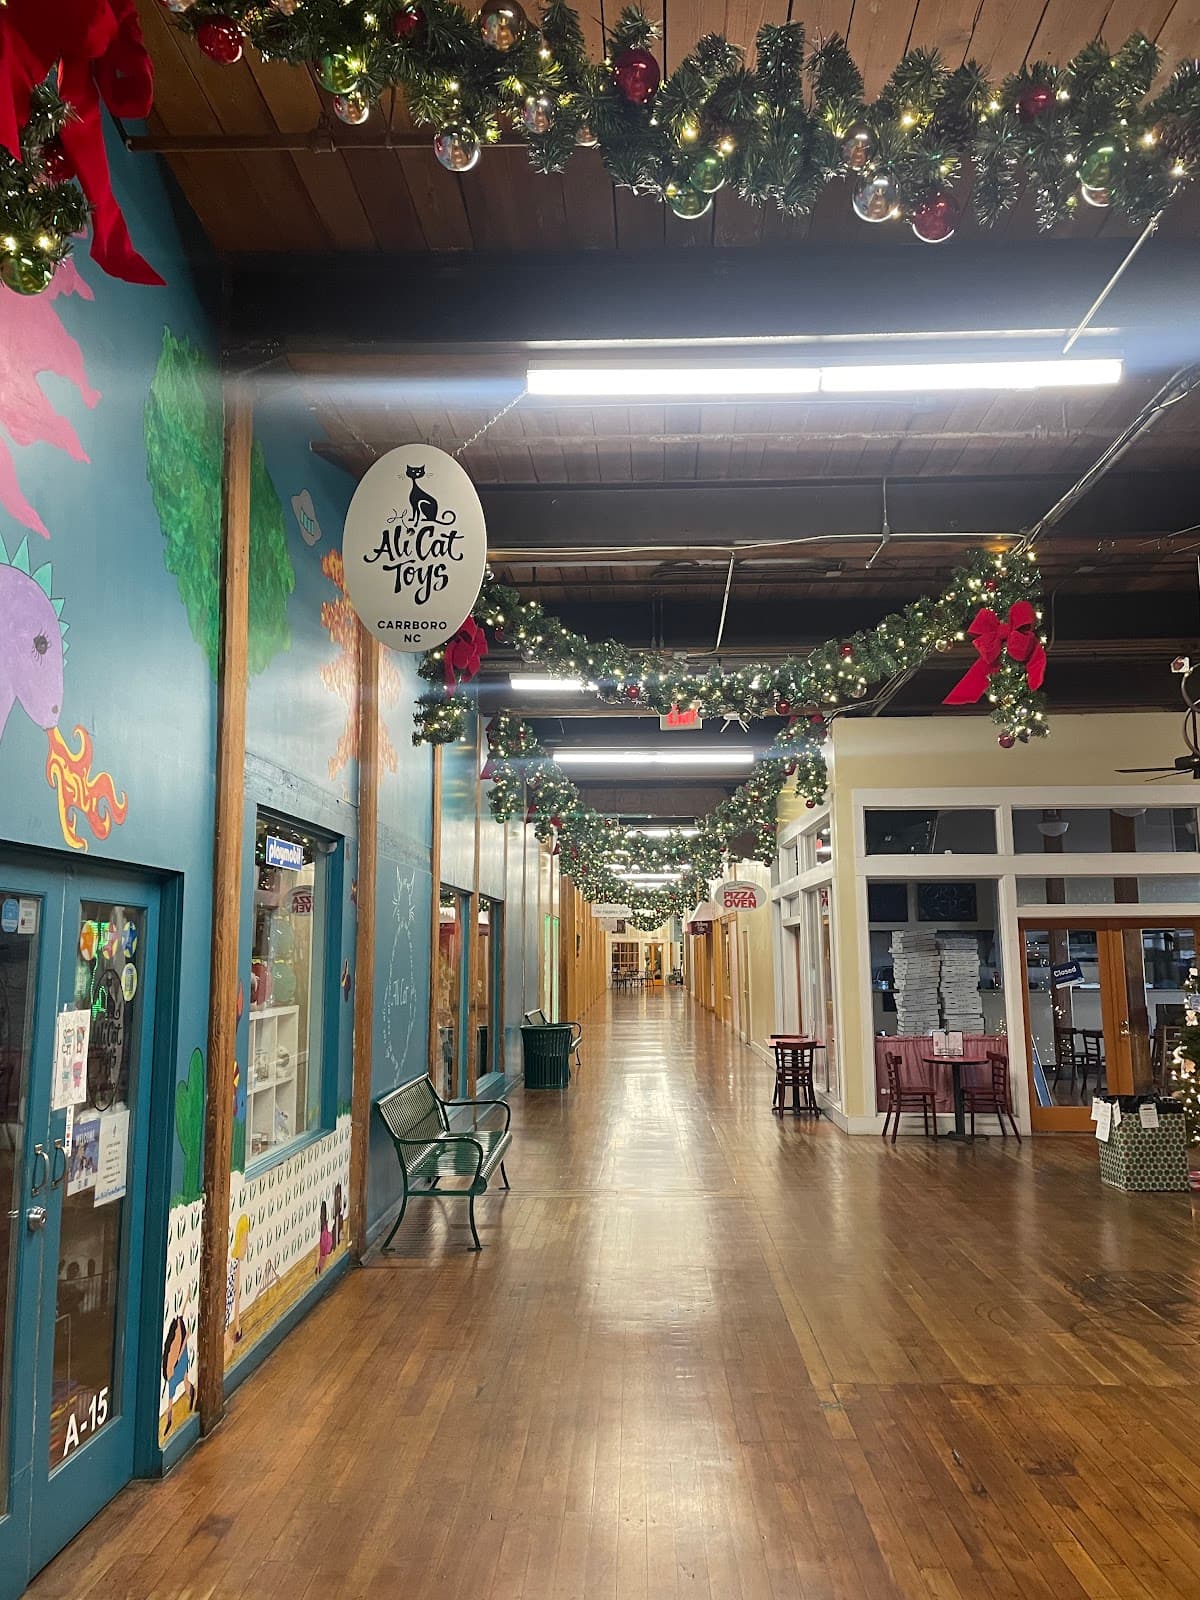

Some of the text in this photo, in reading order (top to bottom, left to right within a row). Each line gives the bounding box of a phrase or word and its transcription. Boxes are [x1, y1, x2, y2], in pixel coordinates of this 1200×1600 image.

[382, 559, 449, 605] Toys
[377, 620, 448, 630] CARRBORO
[403, 635, 421, 643] NC
[723, 891, 756, 900] PIZZA
[724, 899, 757, 908] OVEN
[1053, 965, 1077, 977] Closed
[62, 1386, 109, 1457] A-15
